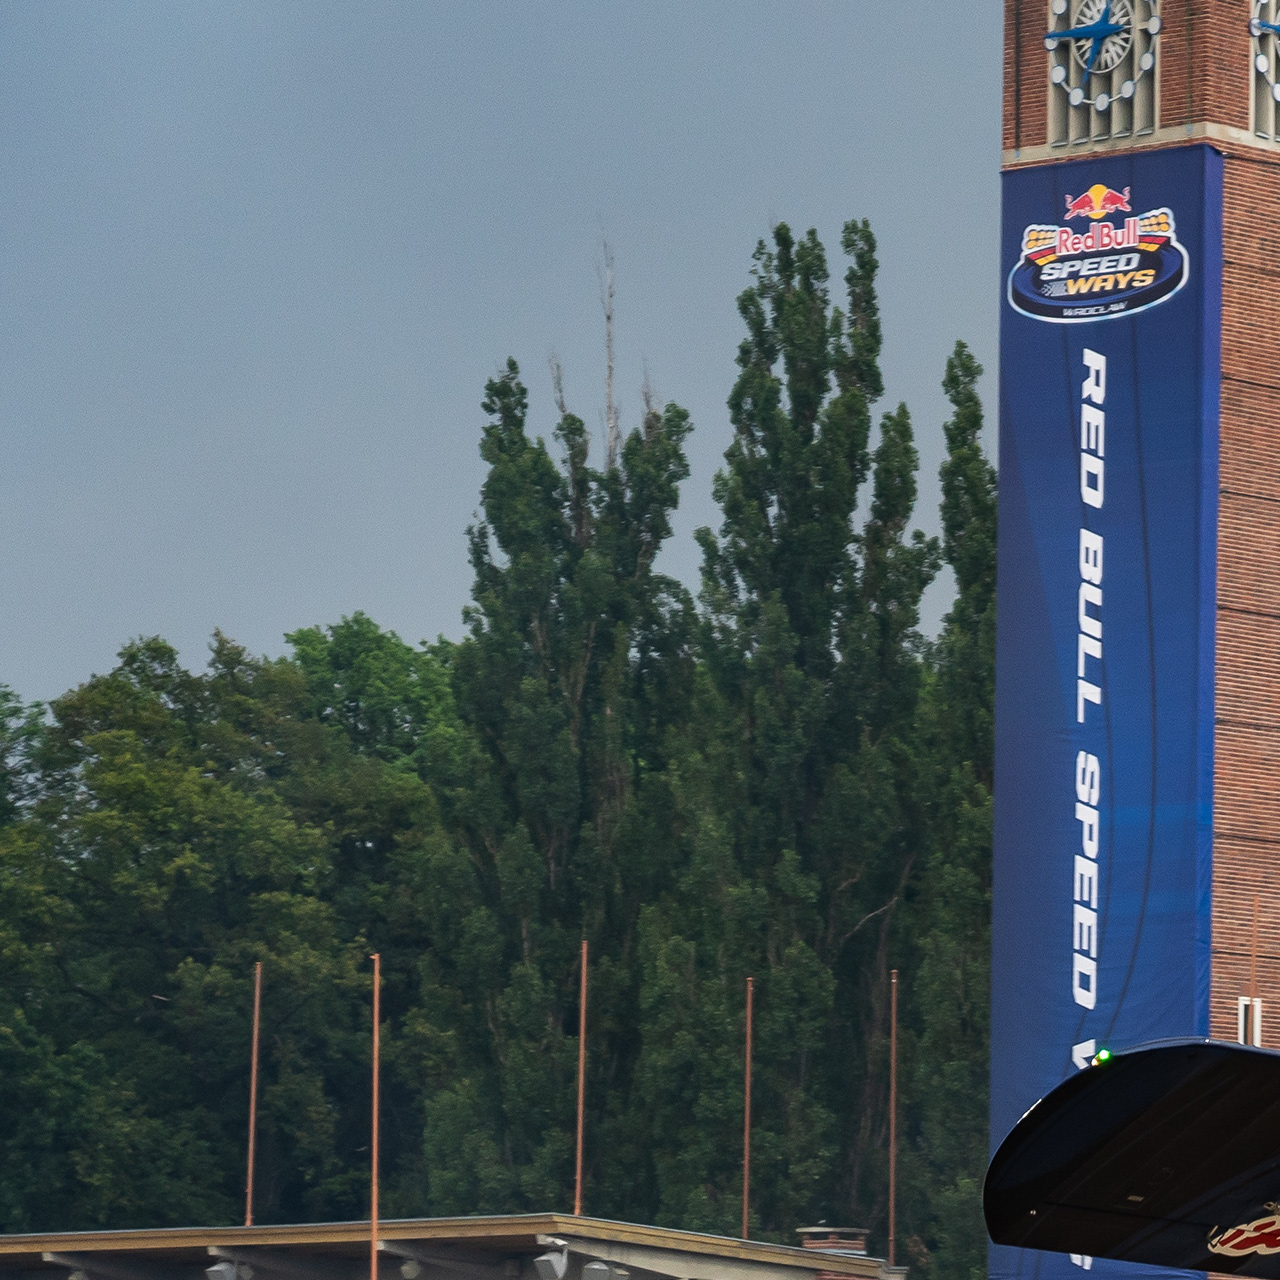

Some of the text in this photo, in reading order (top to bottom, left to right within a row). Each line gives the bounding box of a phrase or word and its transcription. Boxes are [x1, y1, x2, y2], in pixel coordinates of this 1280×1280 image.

[1040, 253, 1141, 281] SPEED
[1056, 218, 1139, 256] Red Bull
[1066, 269, 1156, 296] WAYS
[1080, 347, 1107, 509] RED
[1077, 529, 1105, 723] BULL
[1071, 751, 1101, 1010] SPEED
